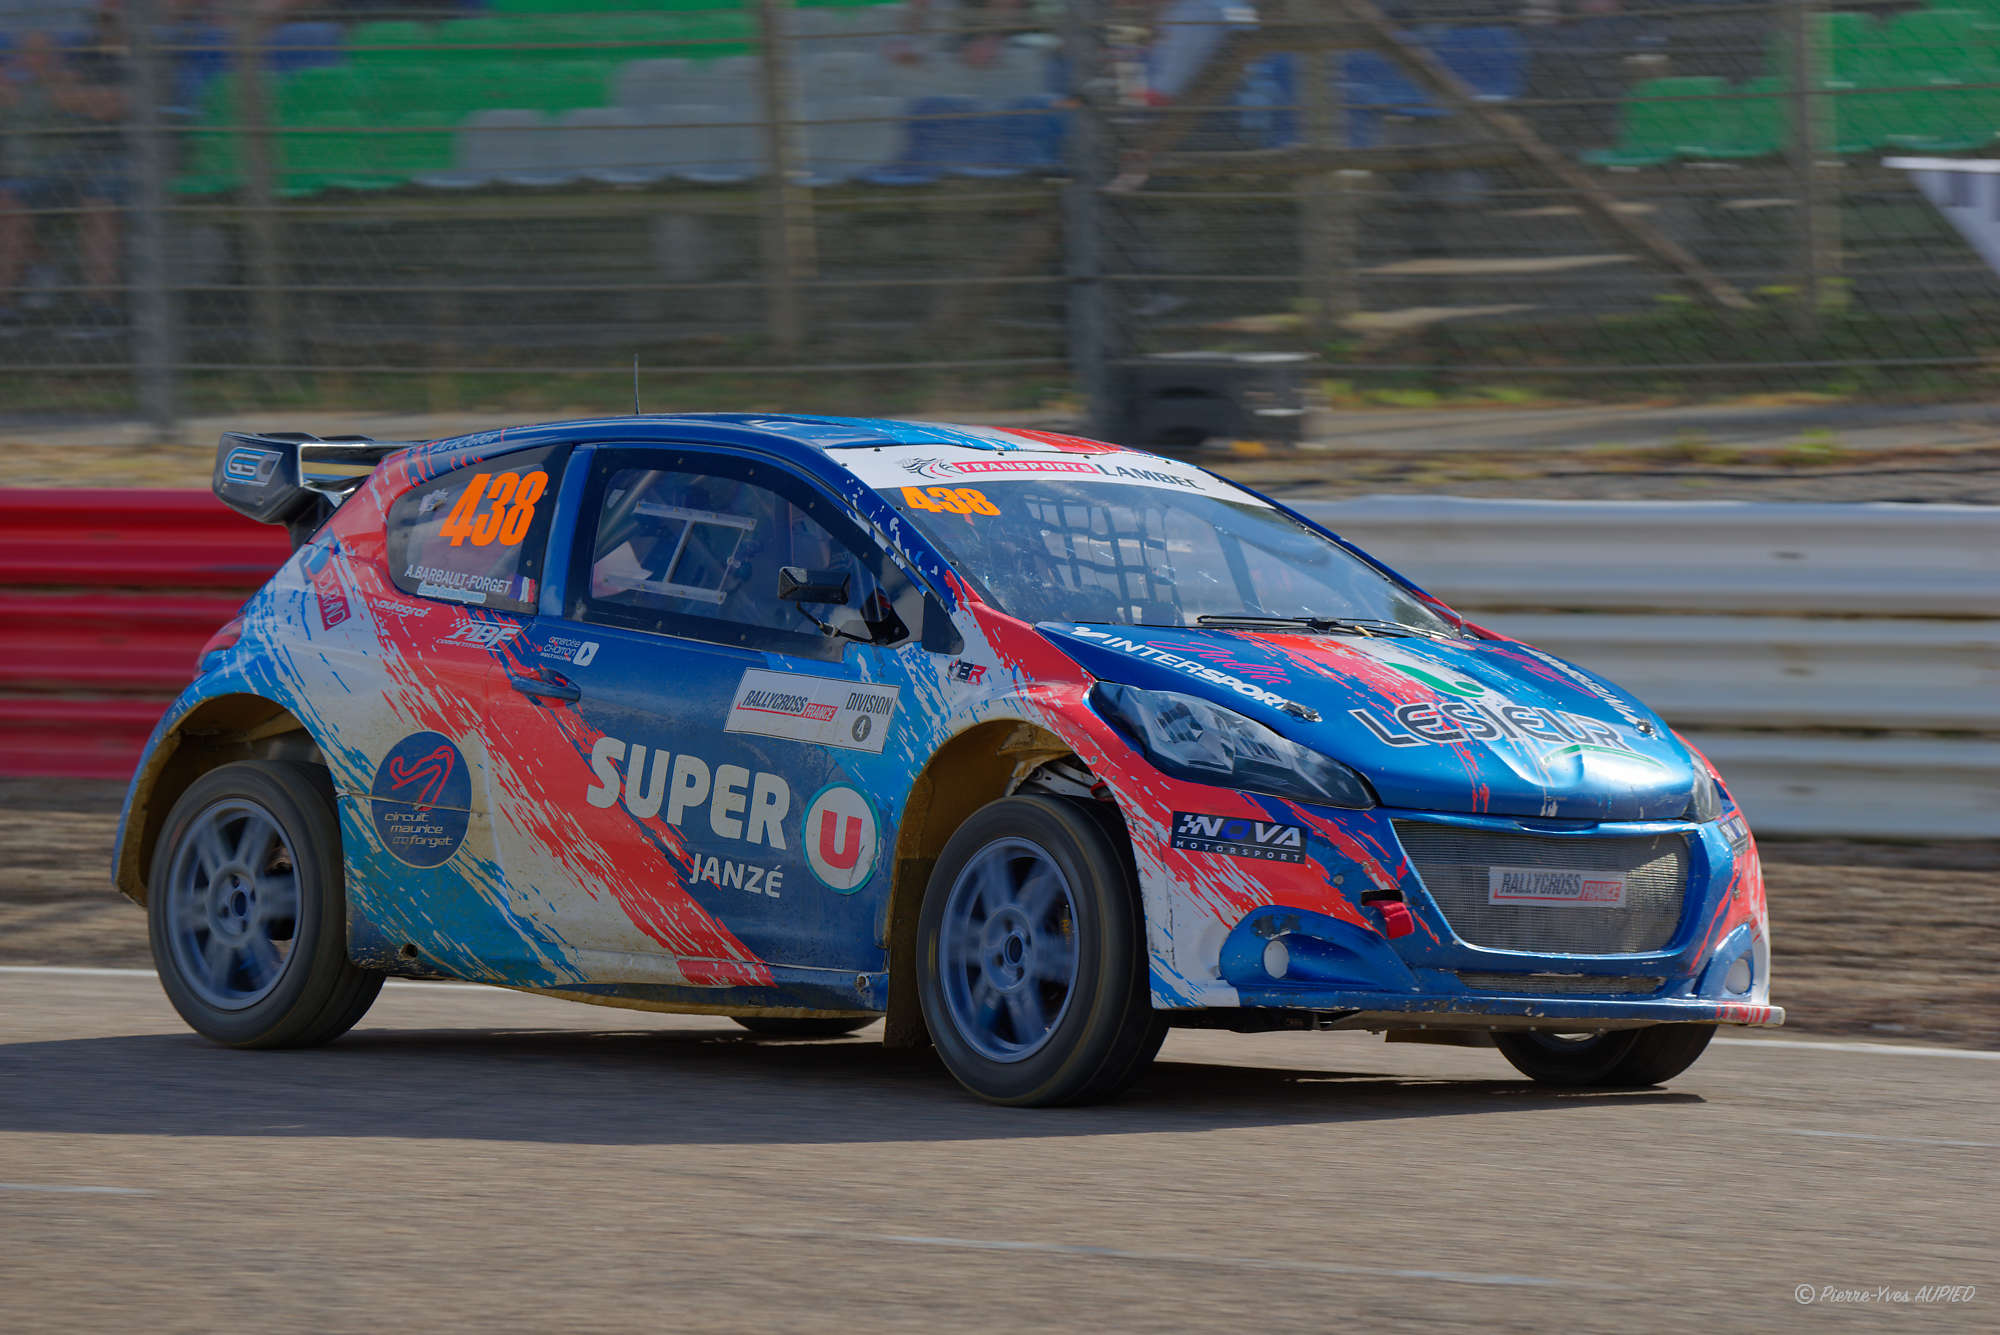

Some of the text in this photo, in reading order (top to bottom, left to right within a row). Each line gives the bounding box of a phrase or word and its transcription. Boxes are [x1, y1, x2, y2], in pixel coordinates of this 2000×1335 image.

[957, 462, 1093, 473] TRANSPORTS
[440, 471, 549, 547] 438
[901, 486, 1001, 516] 438
[404, 564, 512, 594] A.BARBAULT-FORGET
[742, 690, 836, 721] RALLYCROSS FRANCE
[845, 692, 894, 715] DIVISION
[1349, 703, 1633, 752] LESIEUR
[384, 811, 430, 822] circuit
[586, 736, 862, 869] SUPER U
[390, 824, 443, 834] maurice
[1189, 815, 1301, 847] NOVA
[1176, 841, 1300, 861] MOTORSPORT
[689, 853, 784, 898] JANZÉ
[1500, 872, 1581, 896] RALLYCROSS
